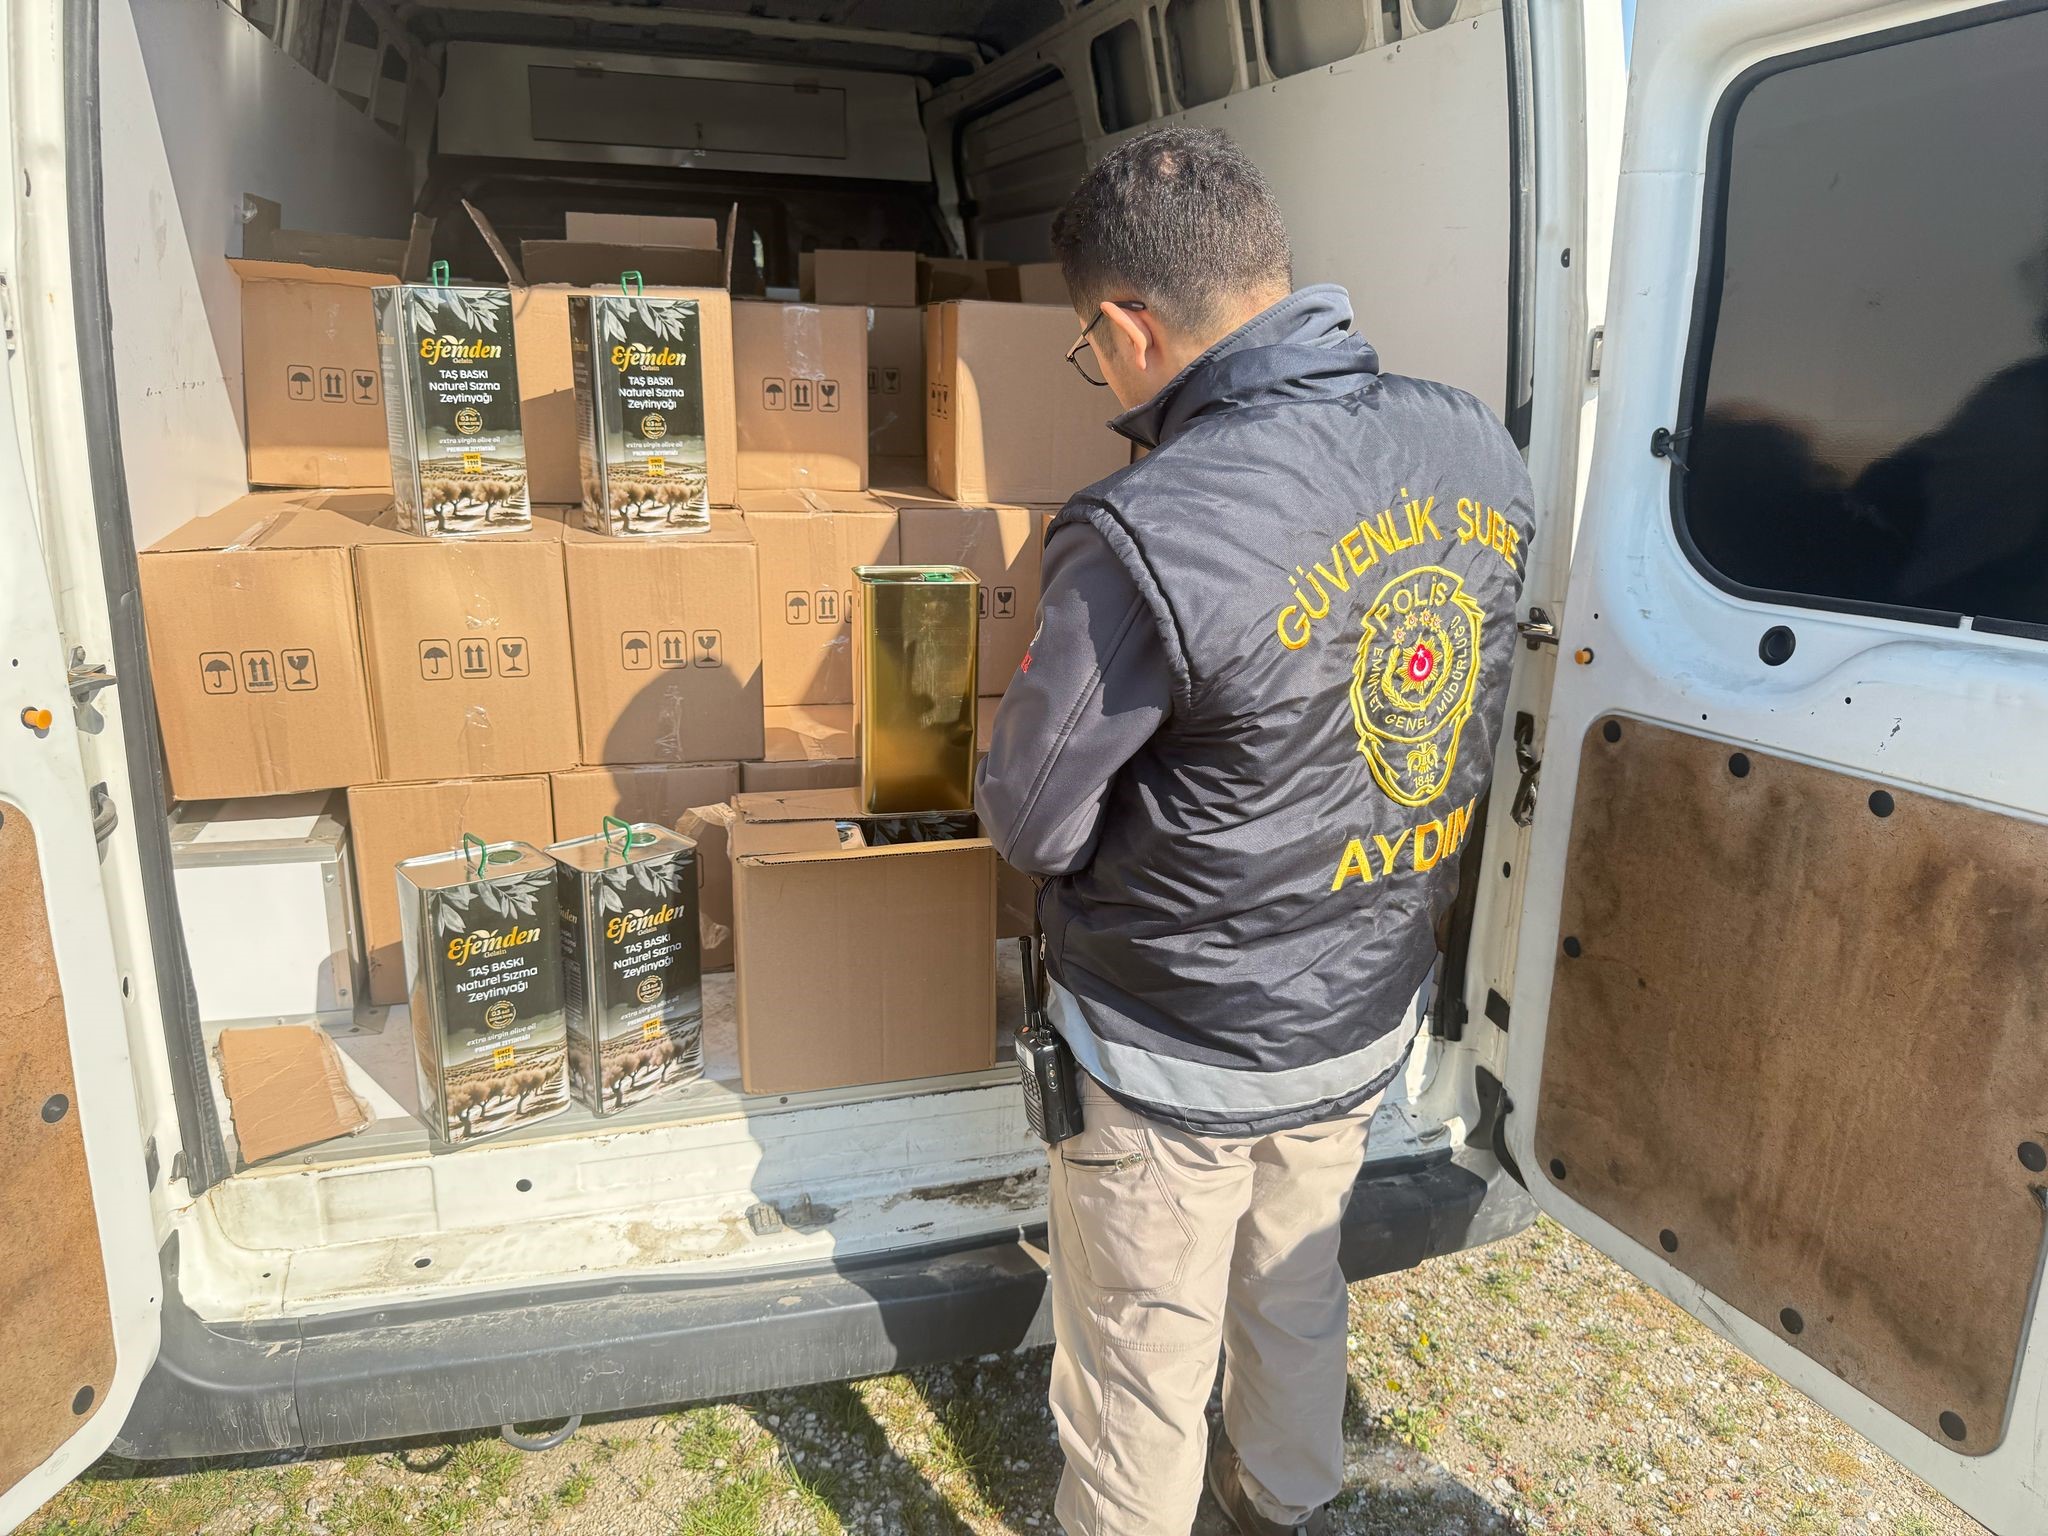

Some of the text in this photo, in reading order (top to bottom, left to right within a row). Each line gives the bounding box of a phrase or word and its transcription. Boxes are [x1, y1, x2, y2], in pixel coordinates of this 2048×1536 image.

[420, 336, 502, 365] Efemden
[611, 343, 687, 373] Efemden
[439, 370, 488, 380] TAŞ BASKI
[628, 376, 674, 386] TAŞ BASKI
[429, 382, 500, 391] Naturel Sızma
[619, 388, 684, 397] Naturel Sızma
[440, 394, 492, 405] Zeytinyağı
[628, 399, 677, 410] Zeytinyağı
[458, 437, 476, 445] virgin
[1277, 488, 1520, 651] GÜVENLİK ŞUBE
[1374, 575, 1448, 631] POLİS
[1384, 714, 1432, 732] GENEL
[1436, 615, 1468, 716] MÜDÜRLÜĞÜ
[1413, 772, 1435, 789] 1845
[1330, 794, 1477, 891] AYDIN
[606, 903, 685, 945] Efemden
[447, 925, 541, 966] Efemden
[624, 934, 670, 954] TAŞ BASKI
[613, 942, 682, 970] Naturel Sızma
[468, 957, 524, 977] TAŞ BASKI
[622, 956, 673, 979] Zeytinyağı
[456, 966, 538, 993] Naturel Sızma
[468, 981, 529, 1003] Zeytinyağı
[620, 1011, 638, 1020] extra
[639, 1003, 657, 1016] virgin
[467, 1037, 487, 1046] extra
[487, 1031, 509, 1040] virgin
[510, 1026, 527, 1035] olive
